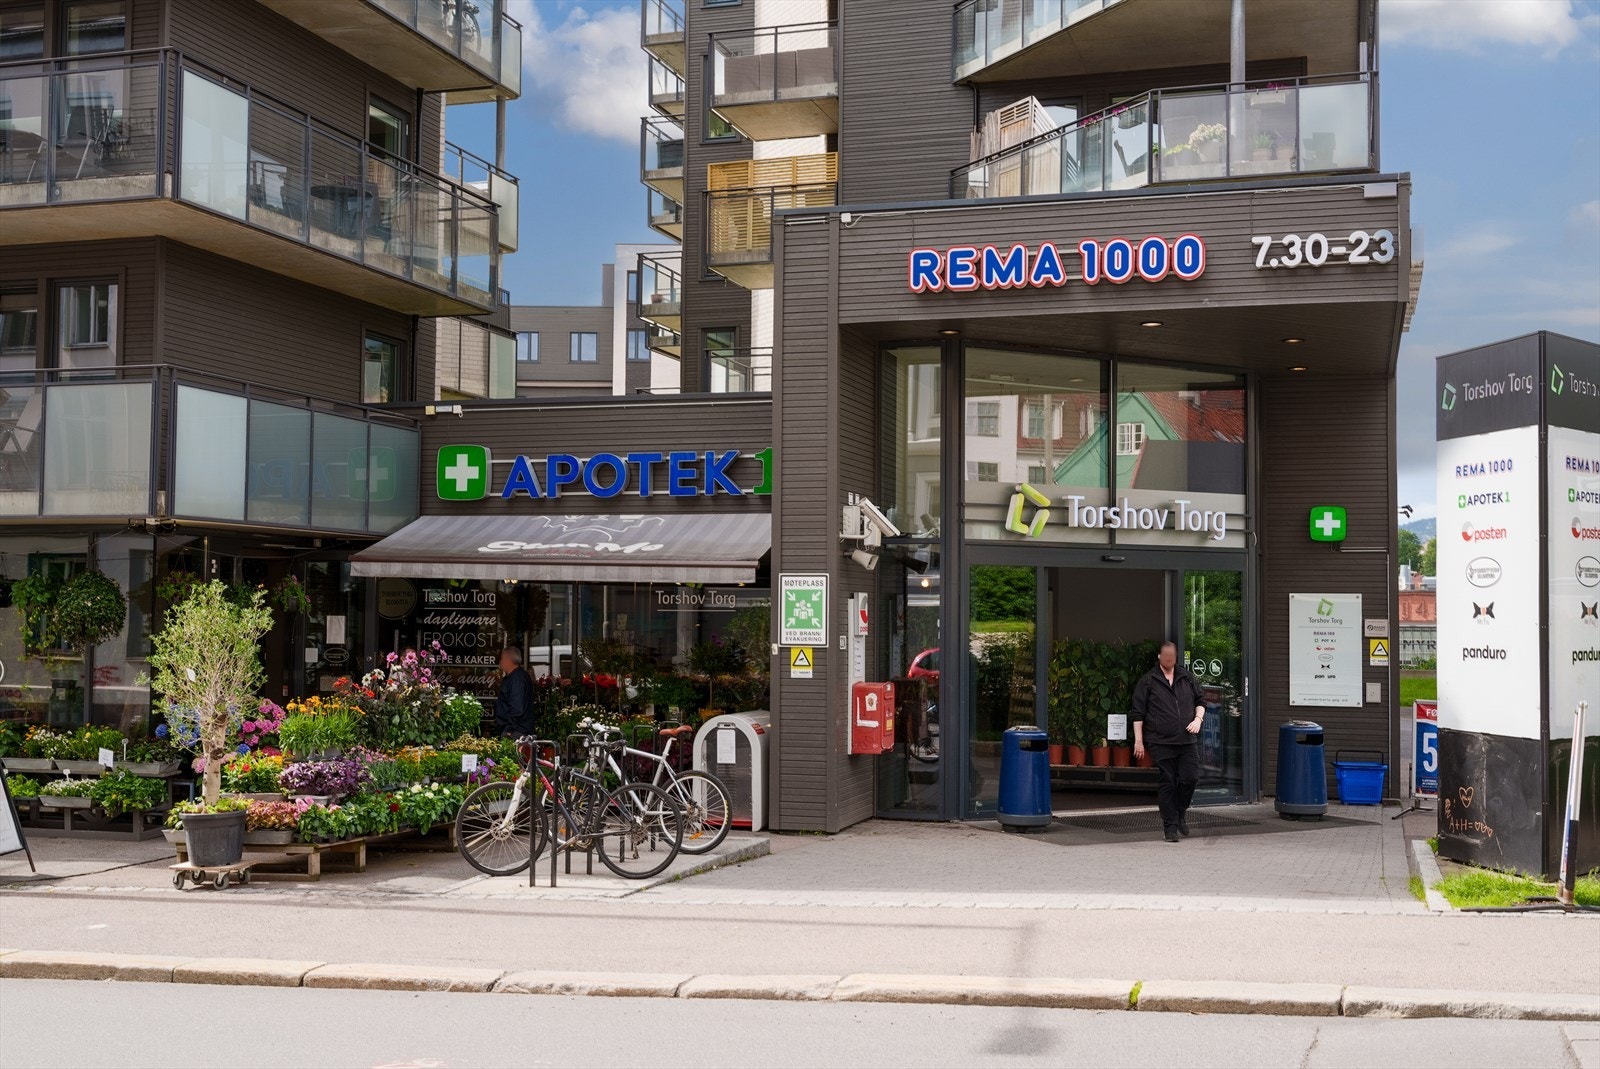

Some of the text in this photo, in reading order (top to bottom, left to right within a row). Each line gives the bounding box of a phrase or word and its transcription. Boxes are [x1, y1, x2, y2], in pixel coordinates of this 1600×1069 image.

[1251, 229, 1395, 269] 7.30-23
[908, 233, 1206, 293] REMA 1000
[1462, 372, 1533, 402] Torshov Torg
[501, 447, 772, 499] APOTEK 1
[1455, 458, 1513, 478] REMA 1000
[1565, 456, 1590, 474] REMA
[1467, 491, 1511, 506] APOTEK 1
[1062, 495, 1227, 540] Torshov Torg
[1474, 526, 1507, 543] posten
[784, 579, 824, 587] MØTEPLASS
[470, 589, 496, 607] Torg
[655, 590, 737, 609] Torshov Torg
[423, 611, 497, 630] dagligvare
[423, 631, 497, 648] FROKOST
[464, 655, 496, 665] KAKER
[1462, 645, 1507, 661] panduro
[457, 674, 497, 689] away
